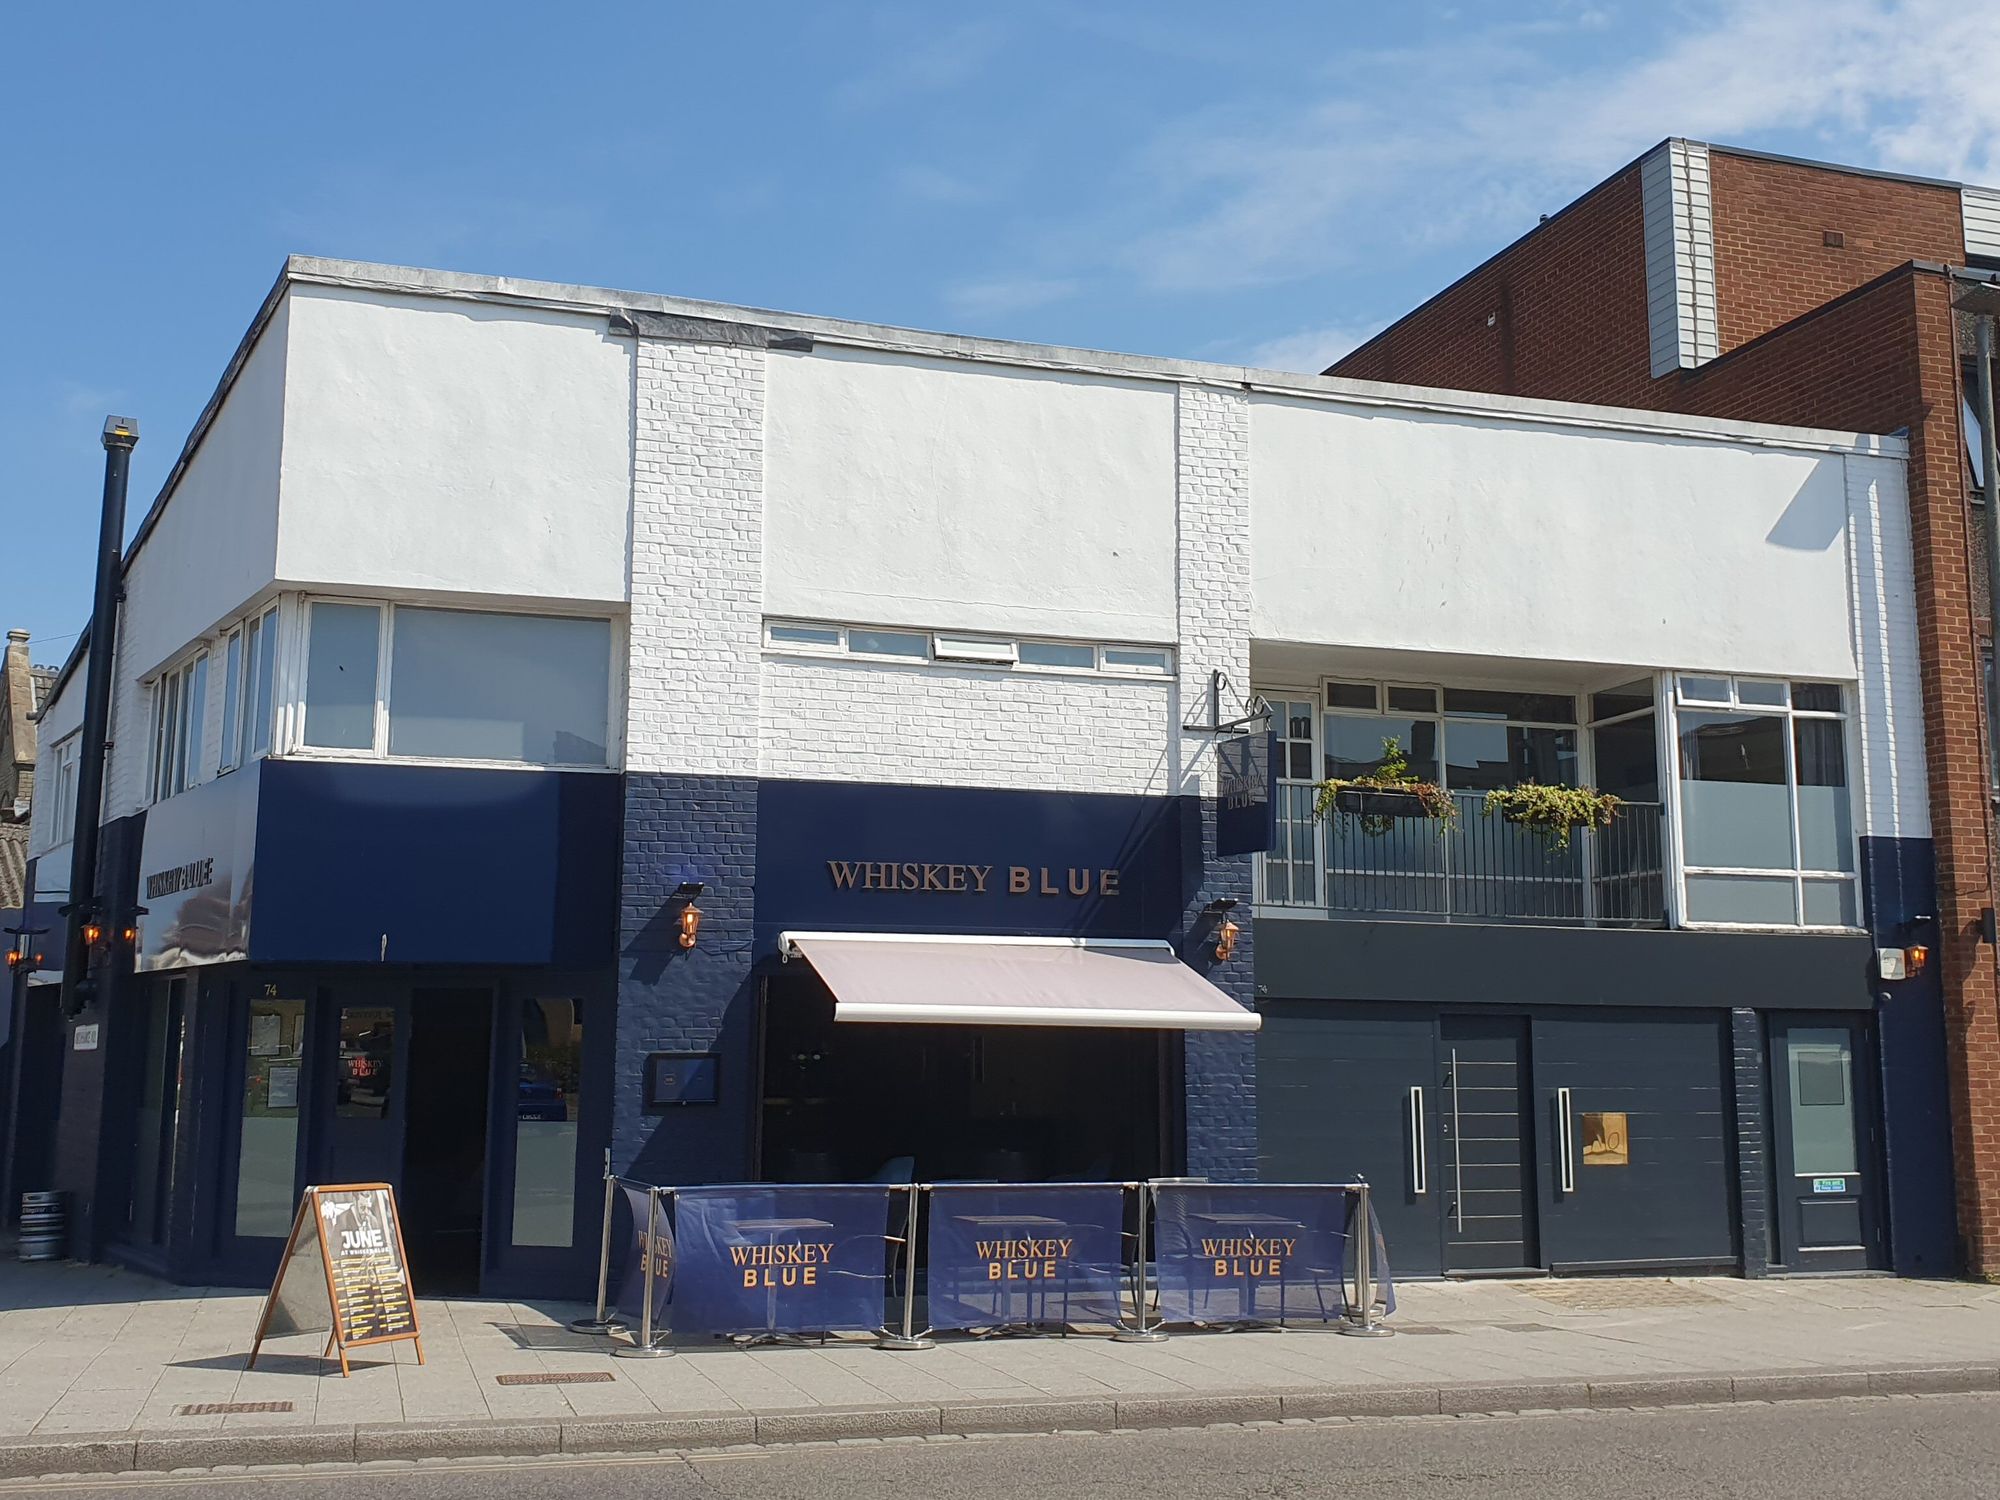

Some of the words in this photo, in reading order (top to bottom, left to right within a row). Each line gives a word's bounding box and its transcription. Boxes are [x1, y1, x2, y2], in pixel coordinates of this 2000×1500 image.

[1227, 793, 1255, 809] BLUE
[826, 860, 993, 892] WHISKEY
[1008, 866, 1121, 896] BLUE
[264, 984, 277, 996] 74
[347, 1058, 383, 1068] WHISKEY
[341, 1229, 384, 1249] JUNE
[1201, 1238, 1297, 1257] WHISKEY
[729, 1243, 834, 1267] WHISKEY
[976, 1239, 1073, 1260] WHISKEY
[640, 1253, 669, 1278] BUE
[989, 1260, 1057, 1280] BLUE
[1214, 1259, 1281, 1277] BLUE
[743, 1266, 817, 1288] BLUE
